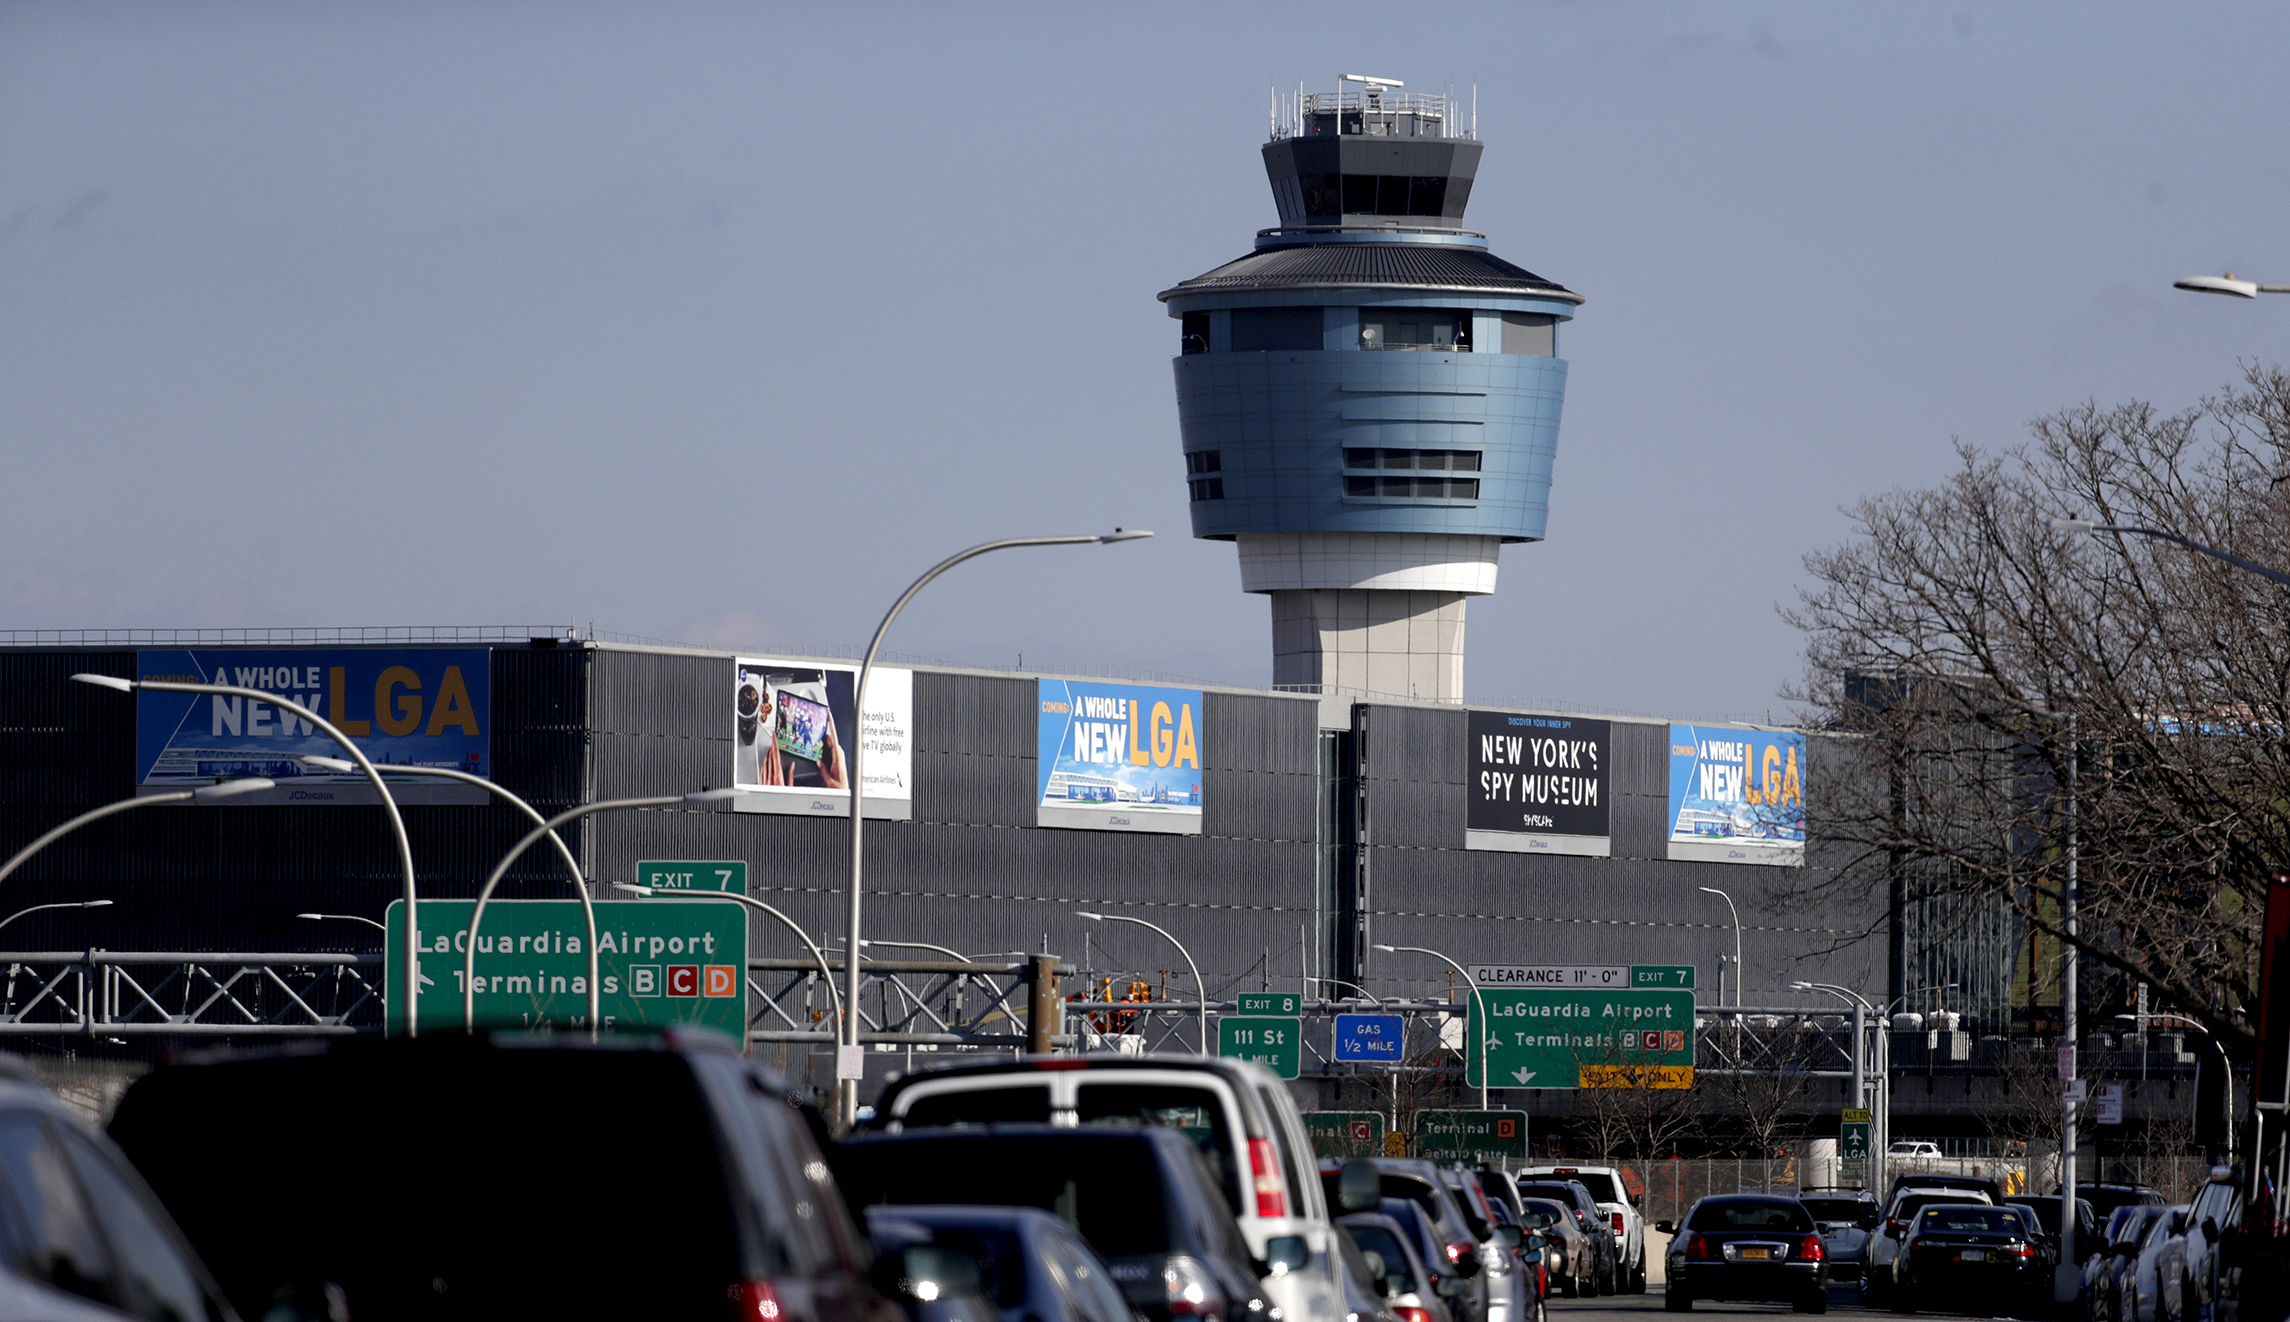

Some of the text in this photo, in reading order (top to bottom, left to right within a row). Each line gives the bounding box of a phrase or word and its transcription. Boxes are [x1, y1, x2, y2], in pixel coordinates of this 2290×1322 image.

[214, 667, 320, 689] A WHOLE
[329, 665, 480, 737] LGA
[1042, 701, 1070, 714] COMING:
[1074, 696, 1127, 720] A WHOLE
[212, 693, 322, 737] NEW
[871, 711, 884, 725] only
[885, 712, 896, 722] U.S.
[1508, 717, 1572, 729] DISCOVER YOUR INNER SPY
[862, 725, 904, 738] irline with free
[1129, 700, 1199, 770] LGA
[871, 740, 879, 750] TV
[1074, 721, 1127, 765] NEW
[1482, 734, 1598, 771] NEW YORK'S
[1700, 740, 1744, 762] A WHOLE
[861, 775, 896, 785] merican Airlines
[1745, 743, 1802, 807] LGA
[1481, 770, 1598, 807] SPY MUSEUM
[1700, 763, 1744, 802] NEW
[288, 790, 335, 801] JCDecaux
[651, 869, 733, 892] EXIT 7
[597, 931, 715, 959] Airport
[453, 969, 729, 994] Terminas B C D
[1478, 969, 1563, 983] CLEARANCE
[1638, 970, 1687, 984] EXIT 7
[1245, 998, 1293, 1012] EXIT 8
[1493, 1003, 1672, 1021] LaGuardia Airport
[570, 1015, 616, 1034] ME
[1357, 1025, 1381, 1035] GAS
[1234, 1030, 1284, 1045] 111 St
[1515, 1032, 1681, 1047] Terminals B C D
[1344, 1039, 1394, 1052] 1/2 MILE
[1252, 1054, 1279, 1066] MILE
[1650, 1070, 1685, 1083] ONLY
[1310, 1124, 1366, 1138] inal C
[1426, 1122, 1511, 1134] Terminal D
[1474, 1149, 1508, 1159] Gates
[1844, 1149, 1867, 1159] LGA
